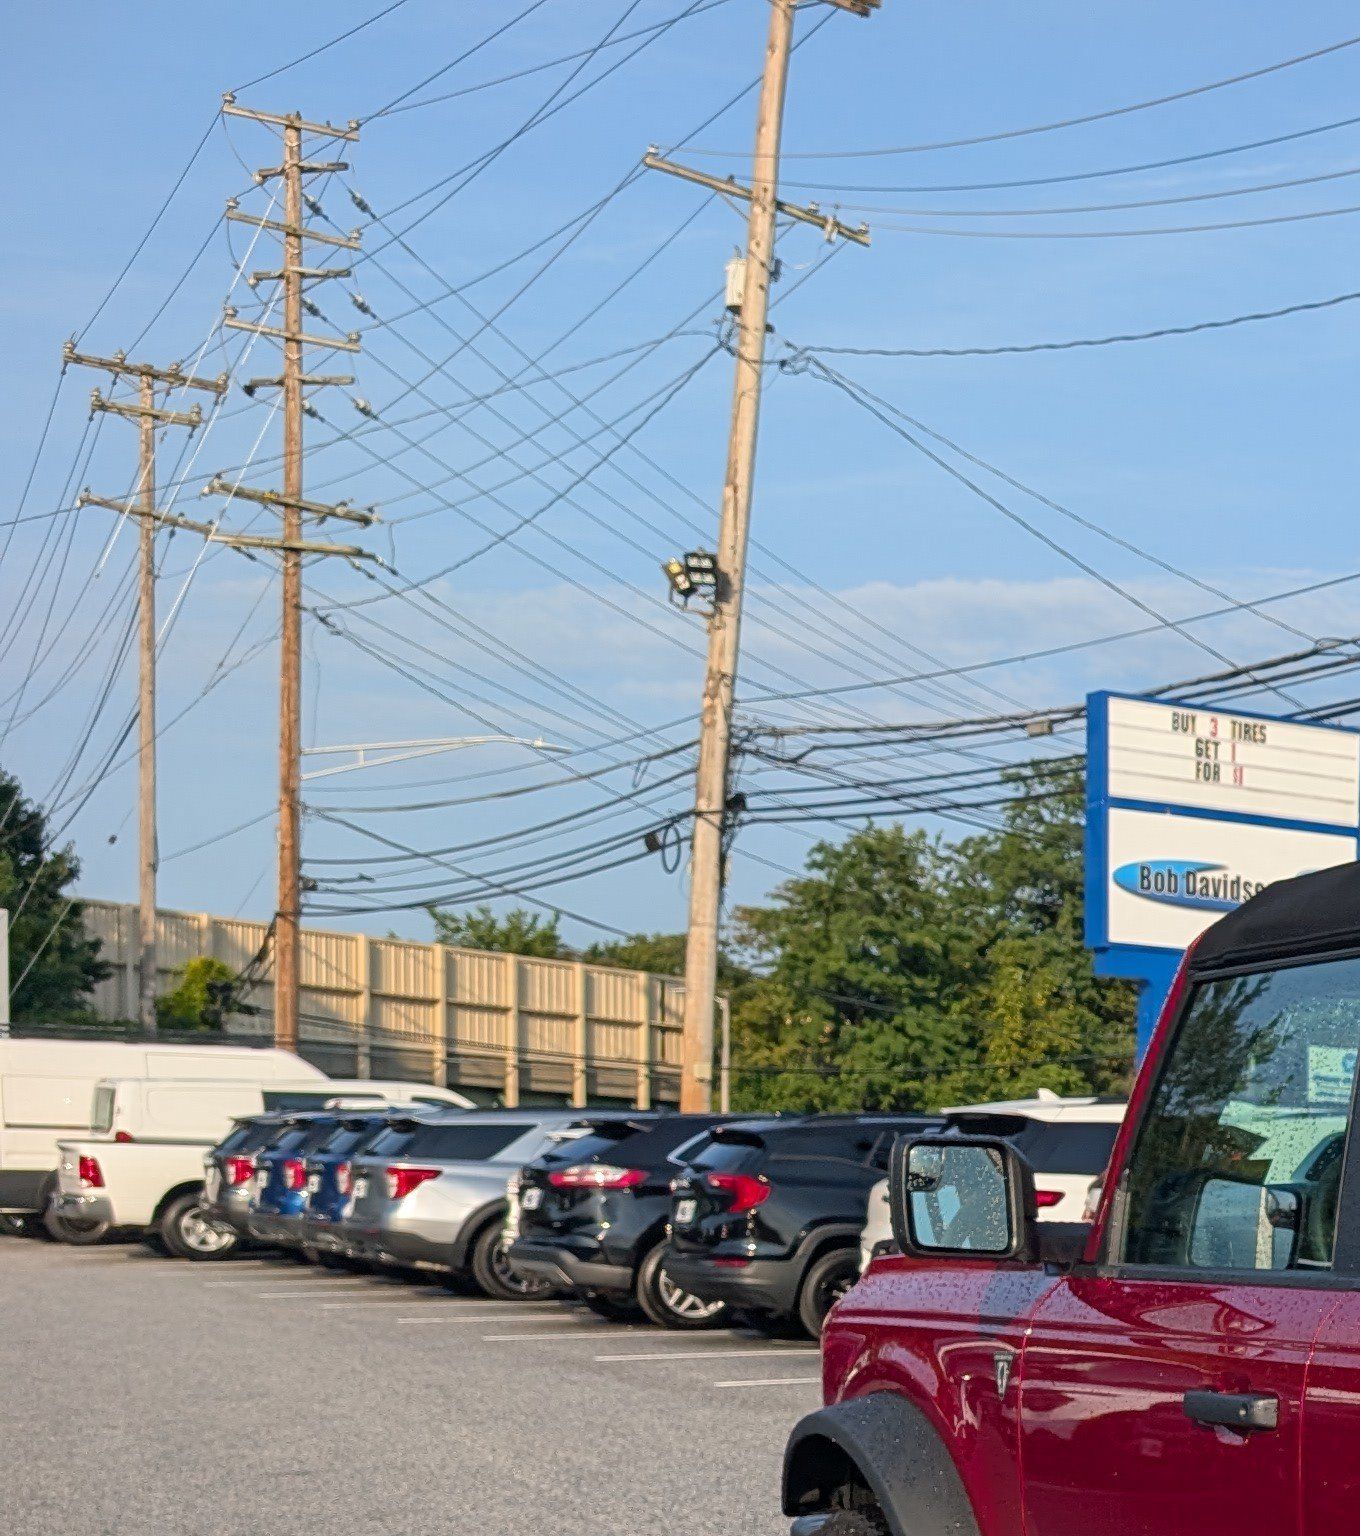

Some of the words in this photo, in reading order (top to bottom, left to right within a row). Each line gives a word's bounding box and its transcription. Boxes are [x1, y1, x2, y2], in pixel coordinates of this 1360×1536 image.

[1171, 710, 1197, 734] BUY
[1209, 716, 1219, 739] 3
[1230, 718, 1267, 744] TIRES
[1195, 738, 1220, 761] GET
[1195, 760, 1221, 783] FOR
[1139, 863, 1179, 895] Bob
[1185, 869, 1265, 903] Davids
